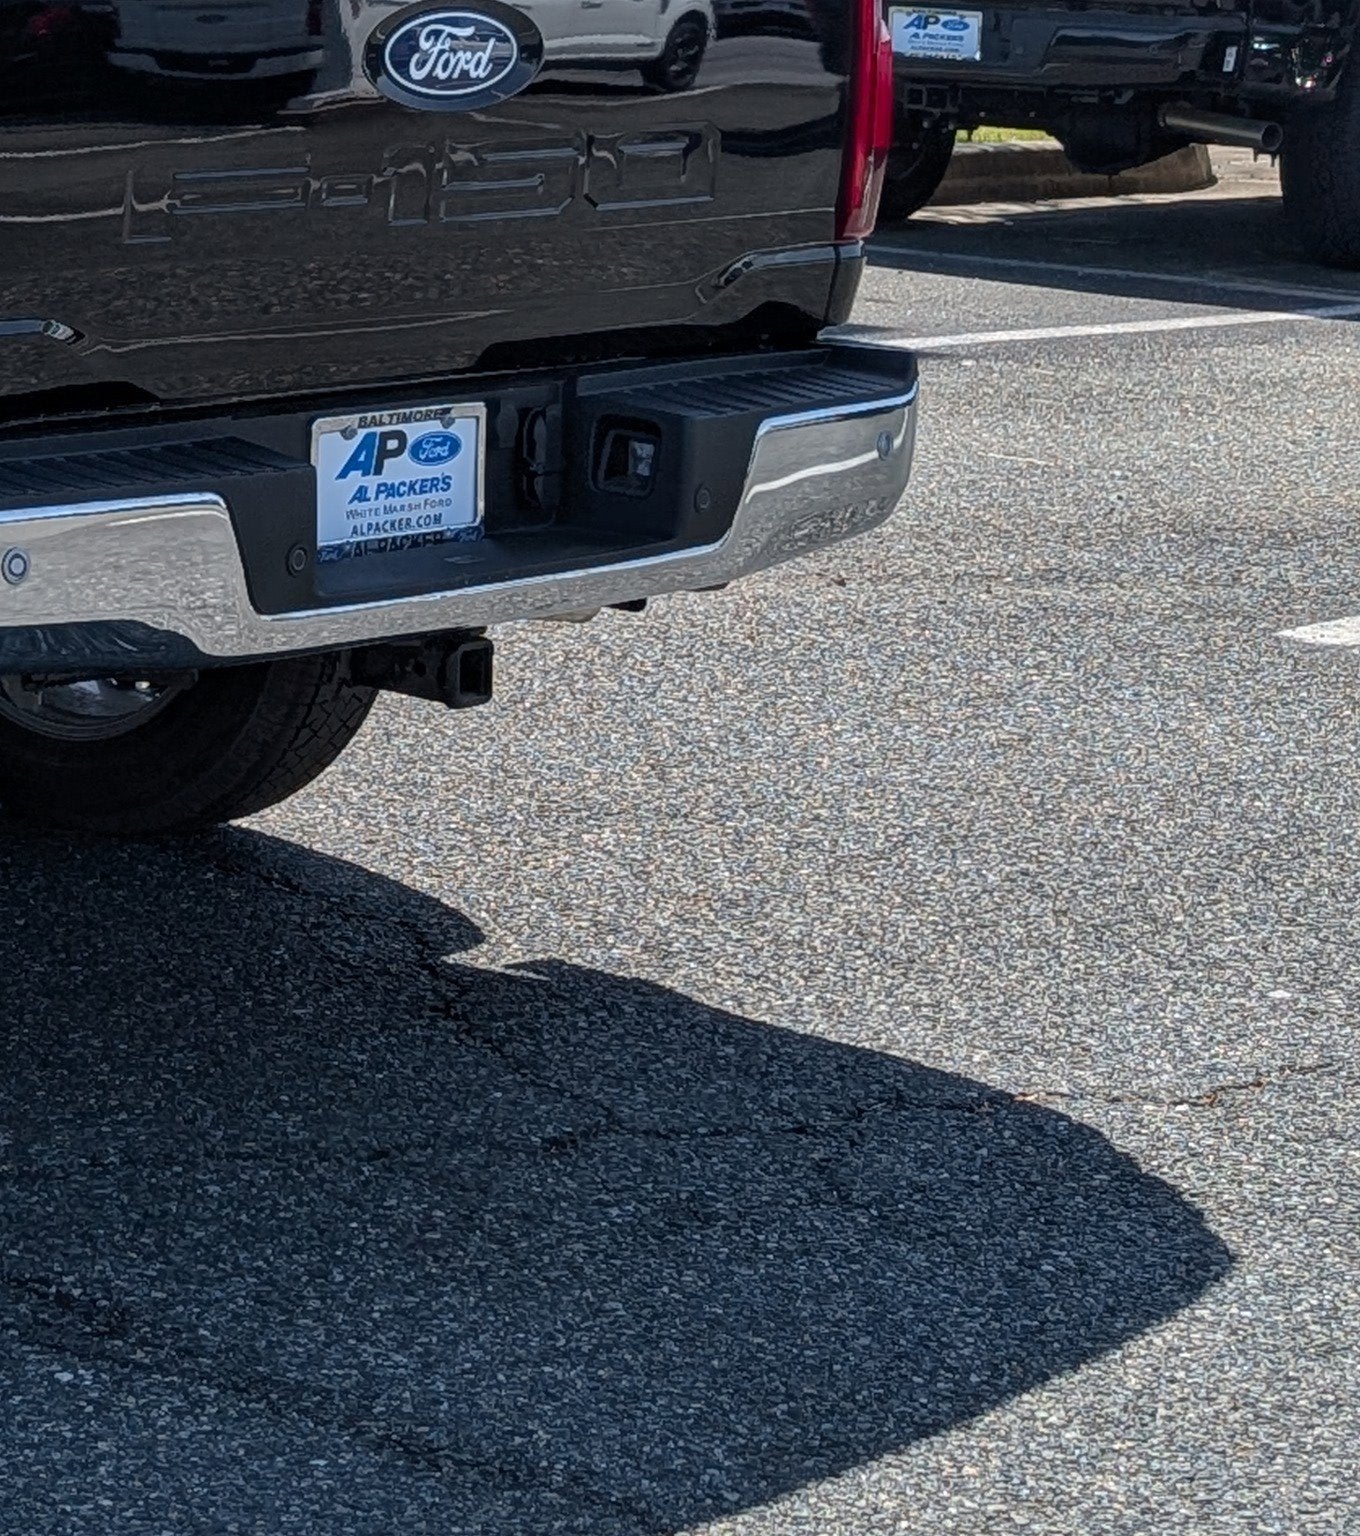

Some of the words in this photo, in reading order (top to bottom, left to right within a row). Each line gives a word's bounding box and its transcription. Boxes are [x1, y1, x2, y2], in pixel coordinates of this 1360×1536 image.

[903, 14, 941, 30] AP
[409, 24, 496, 81] Ford
[357, 408, 446, 429] BALTIMORE
[335, 429, 408, 481] AP
[348, 484, 371, 505] AL
[374, 472, 453, 501] PACKER'S
[350, 513, 443, 538] ALPACKER.COM
